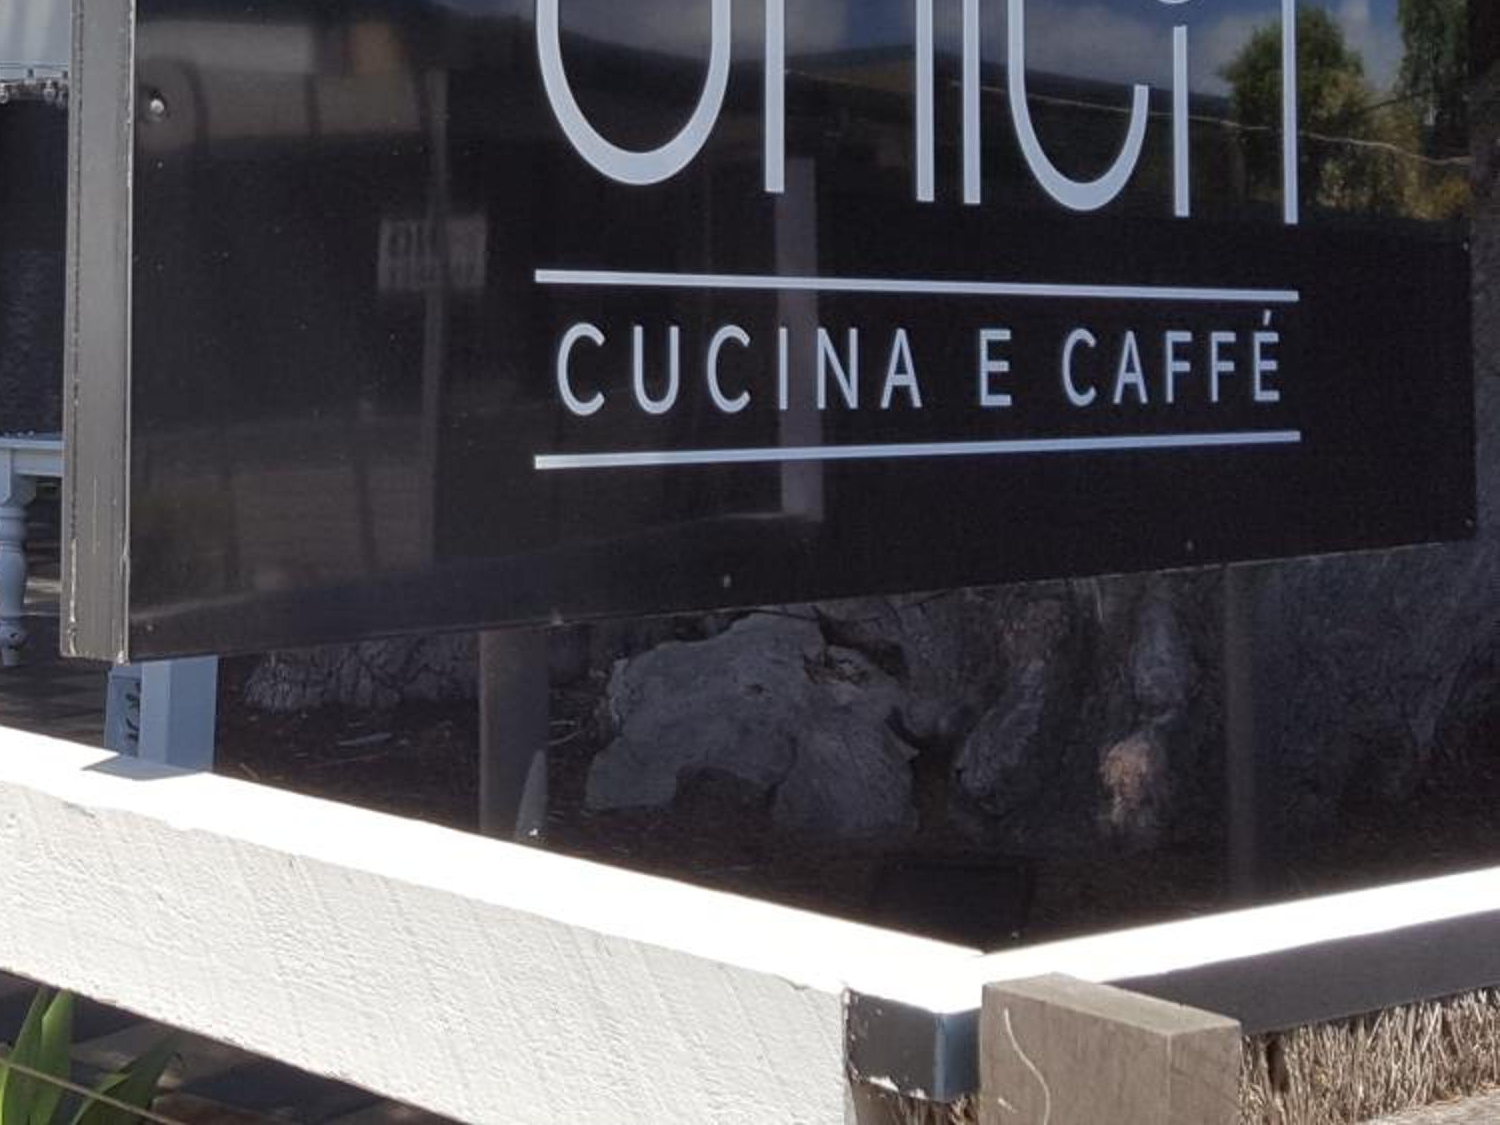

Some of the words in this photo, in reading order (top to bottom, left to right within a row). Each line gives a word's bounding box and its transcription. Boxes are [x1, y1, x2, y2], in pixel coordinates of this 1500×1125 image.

[556, 322, 923, 416] CUCINA
[978, 328, 1012, 407] E
[1062, 310, 1281, 407] CAFFÉ
